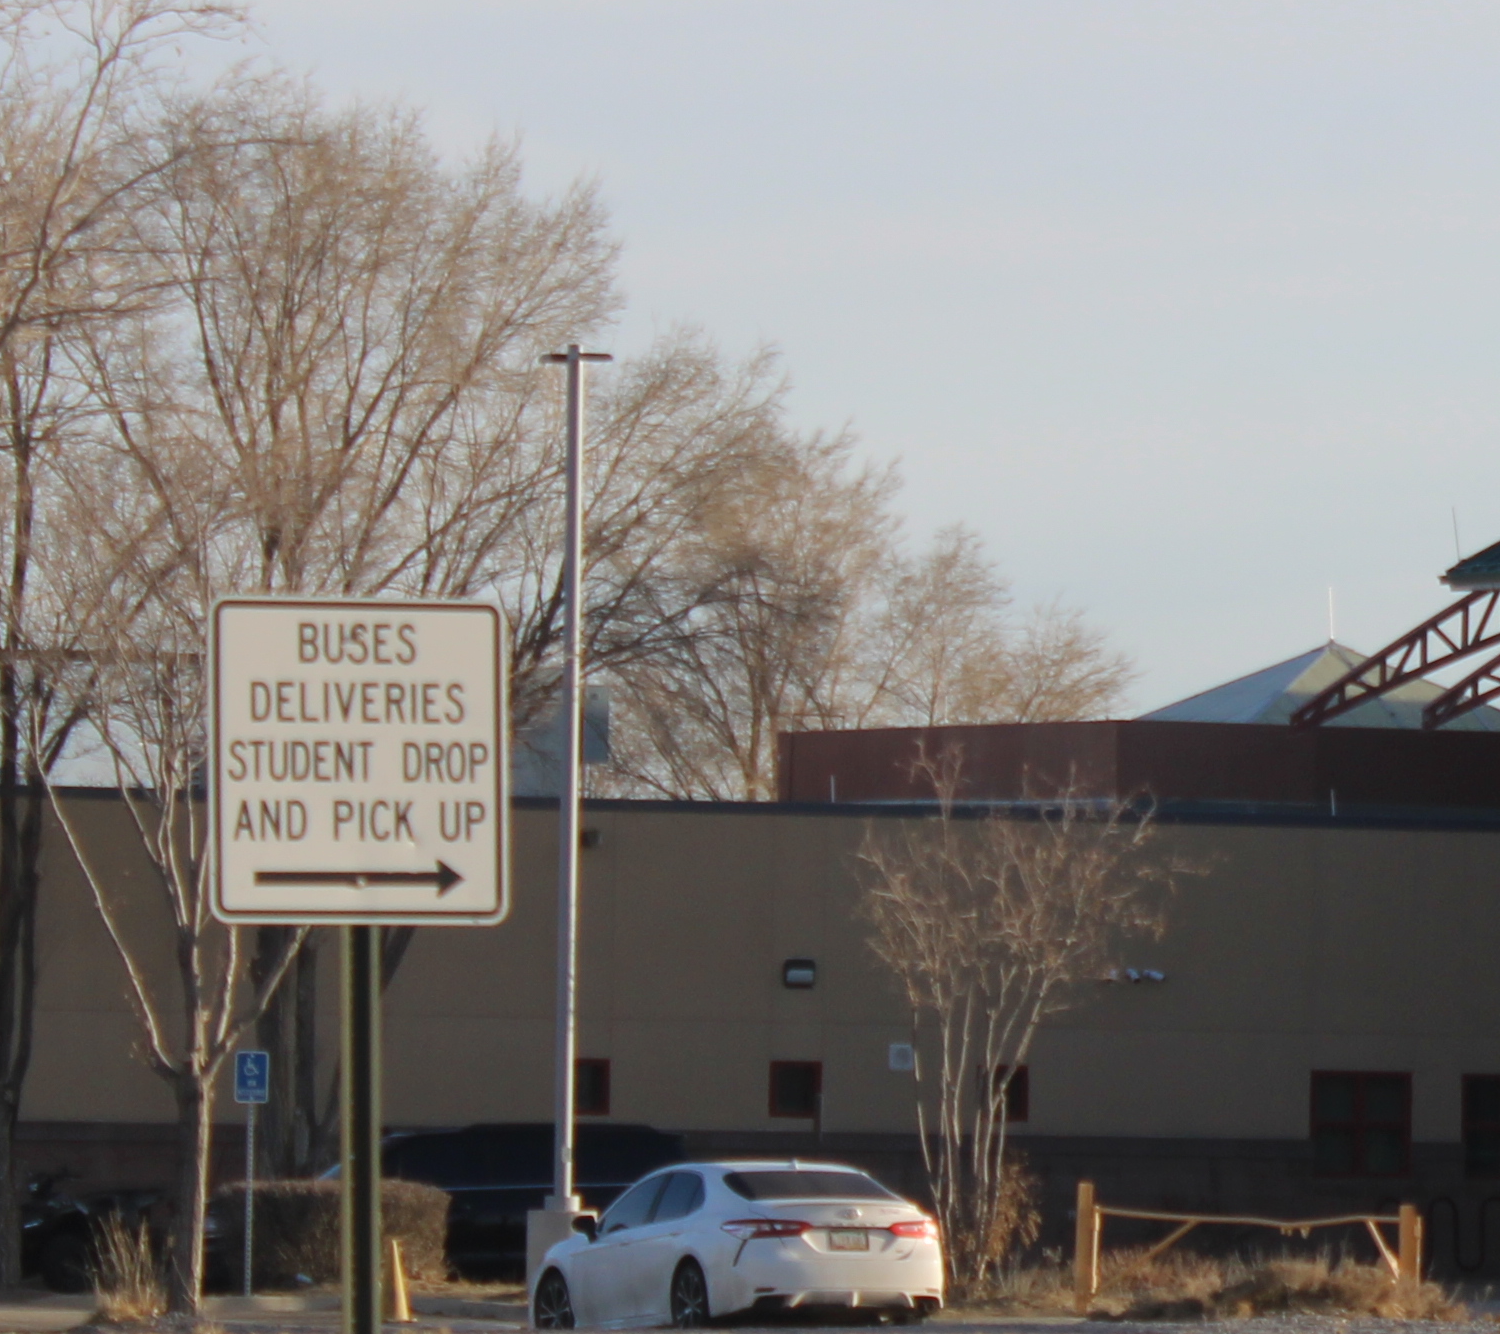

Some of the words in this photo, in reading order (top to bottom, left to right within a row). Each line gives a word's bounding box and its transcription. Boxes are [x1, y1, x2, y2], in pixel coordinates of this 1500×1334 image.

[297, 623, 417, 665] BUSES
[250, 681, 465, 725] DELIVERIES
[228, 740, 374, 782] STUDENT
[403, 742, 489, 783] DROP
[233, 799, 308, 842] AND
[333, 800, 416, 842] PICK
[439, 801, 486, 842] UP
